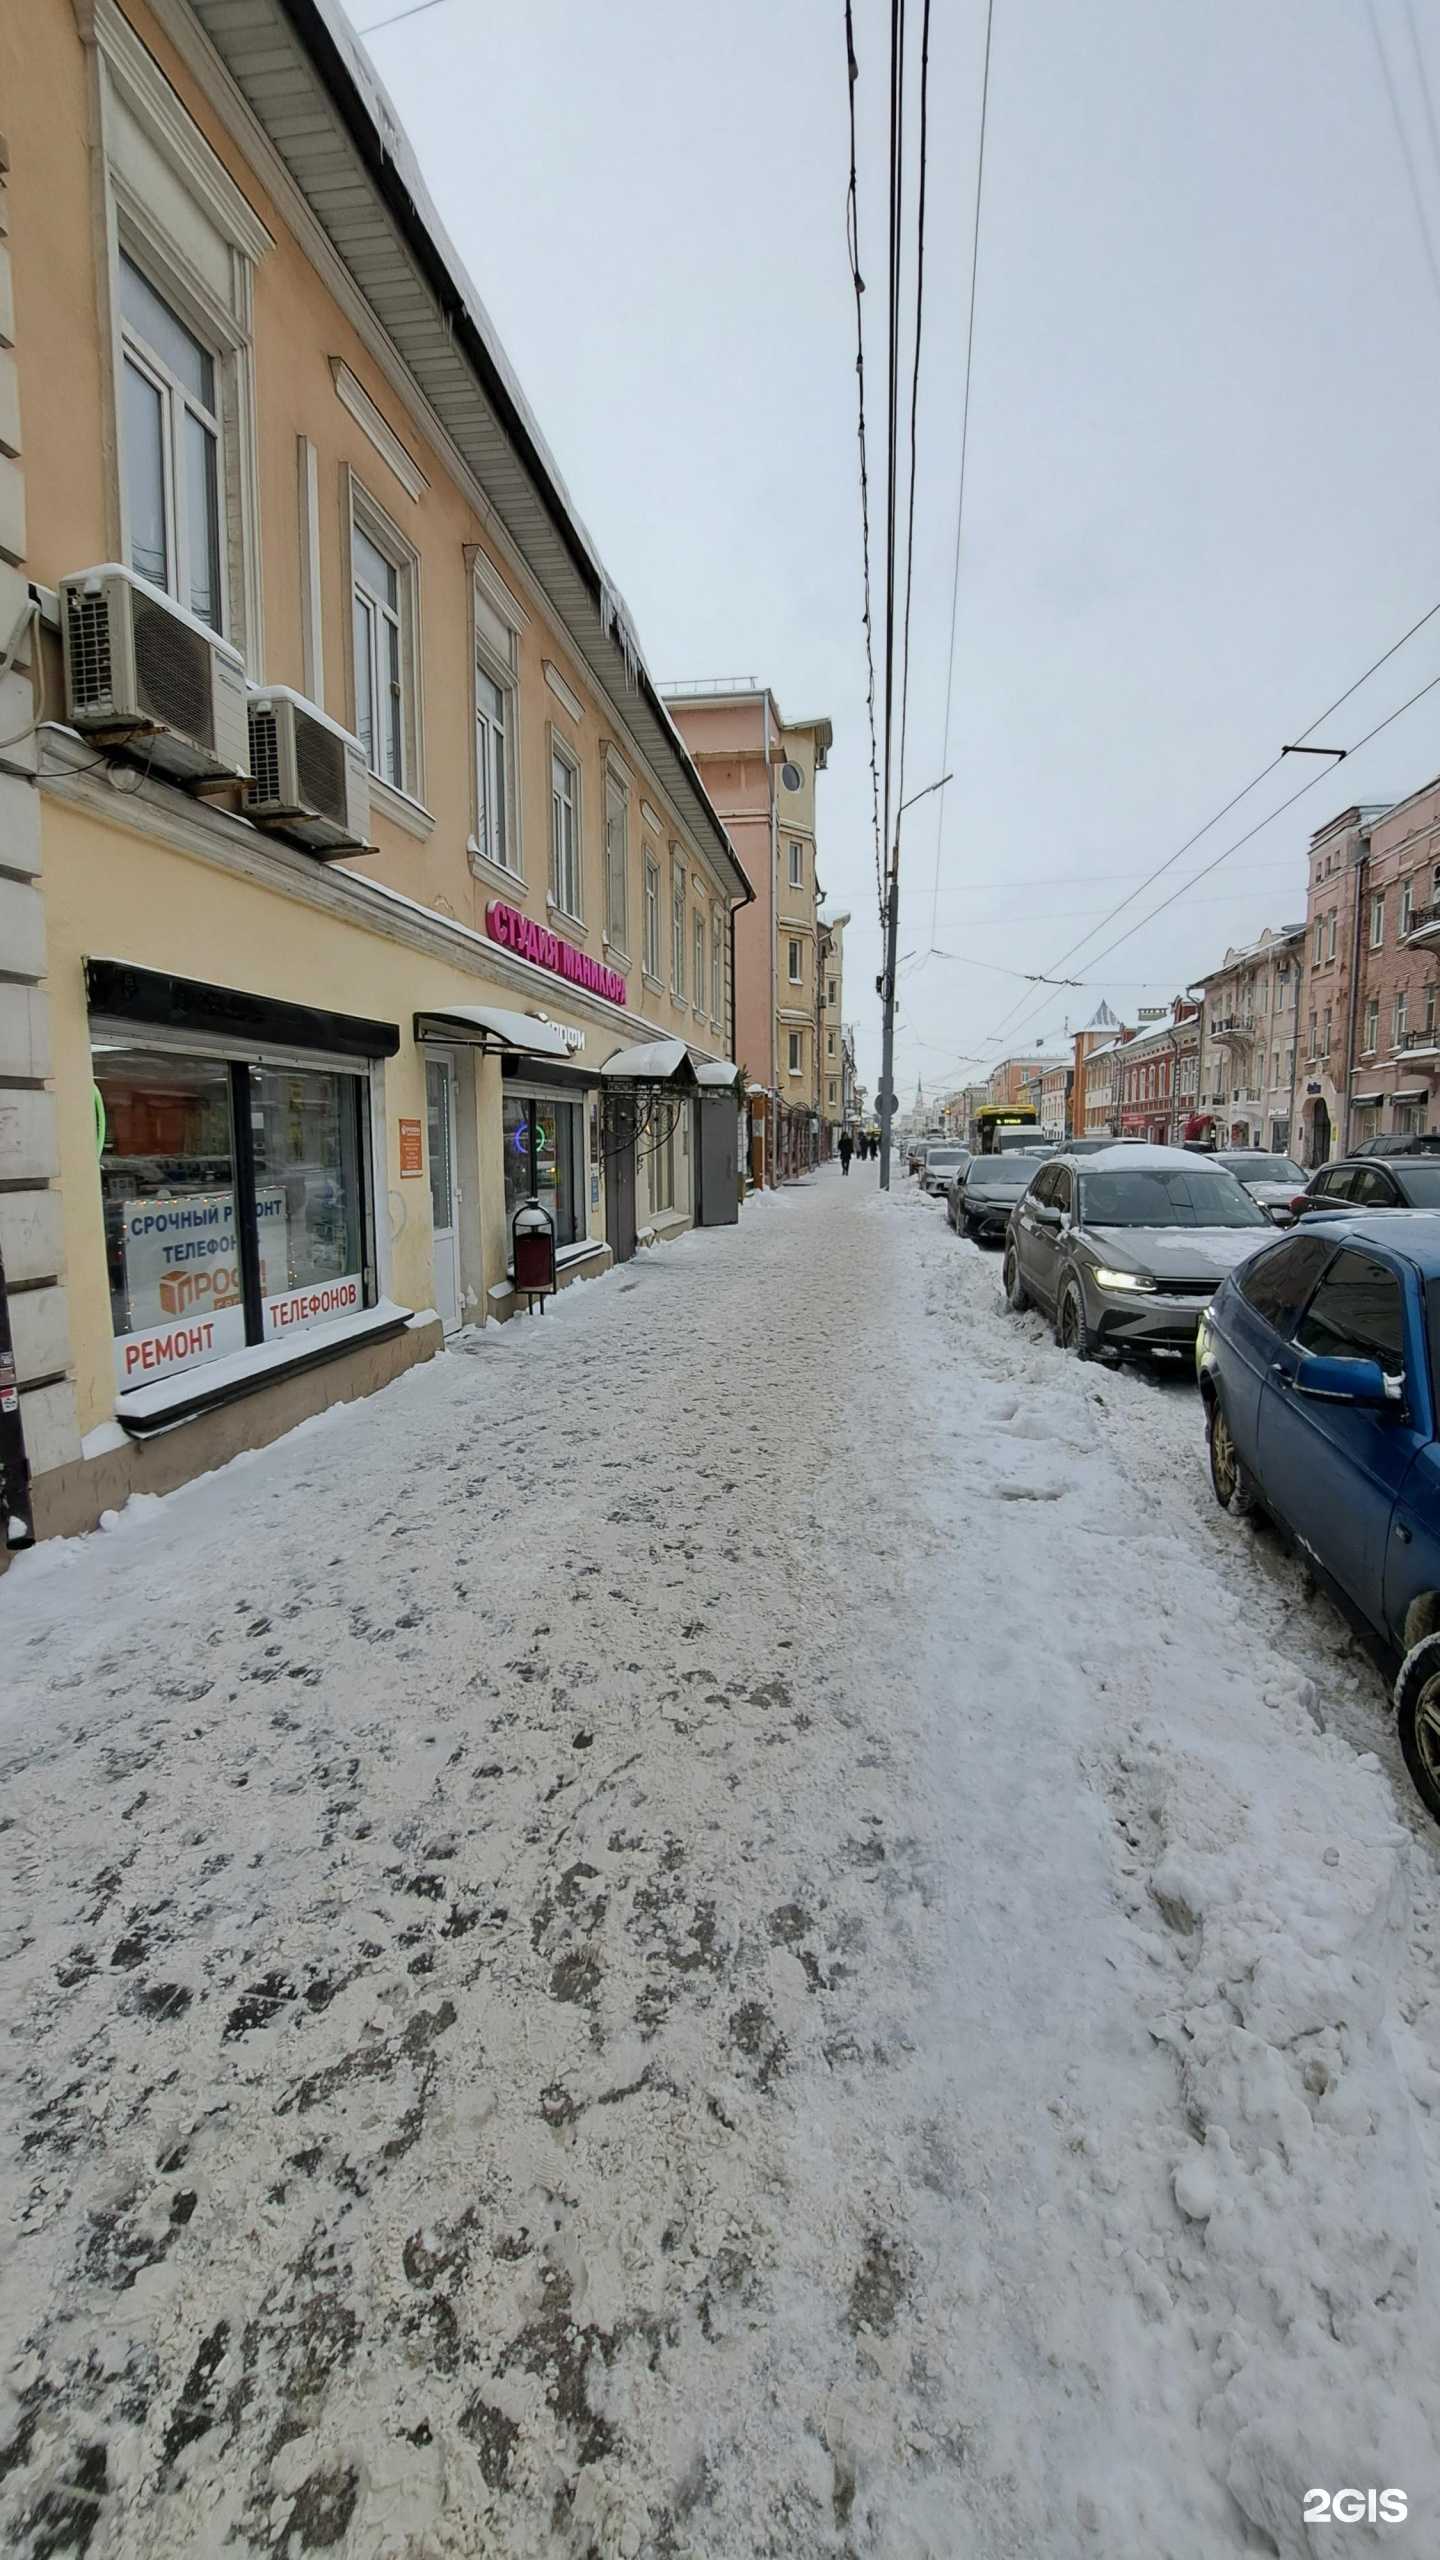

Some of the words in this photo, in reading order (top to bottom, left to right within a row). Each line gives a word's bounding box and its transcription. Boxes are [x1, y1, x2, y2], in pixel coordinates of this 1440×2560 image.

[487, 900, 560, 972] СТУДИЯ
[559, 940, 626, 1006] МАНИКЮРА
[131, 1204, 219, 1236] СРОЧНЫЙ
[223, 1199, 282, 1223] РОНТ
[125, 1323, 214, 1375] РЕМОНТ
[269, 1283, 356, 1329] ТЕЛЕФОНОВ
